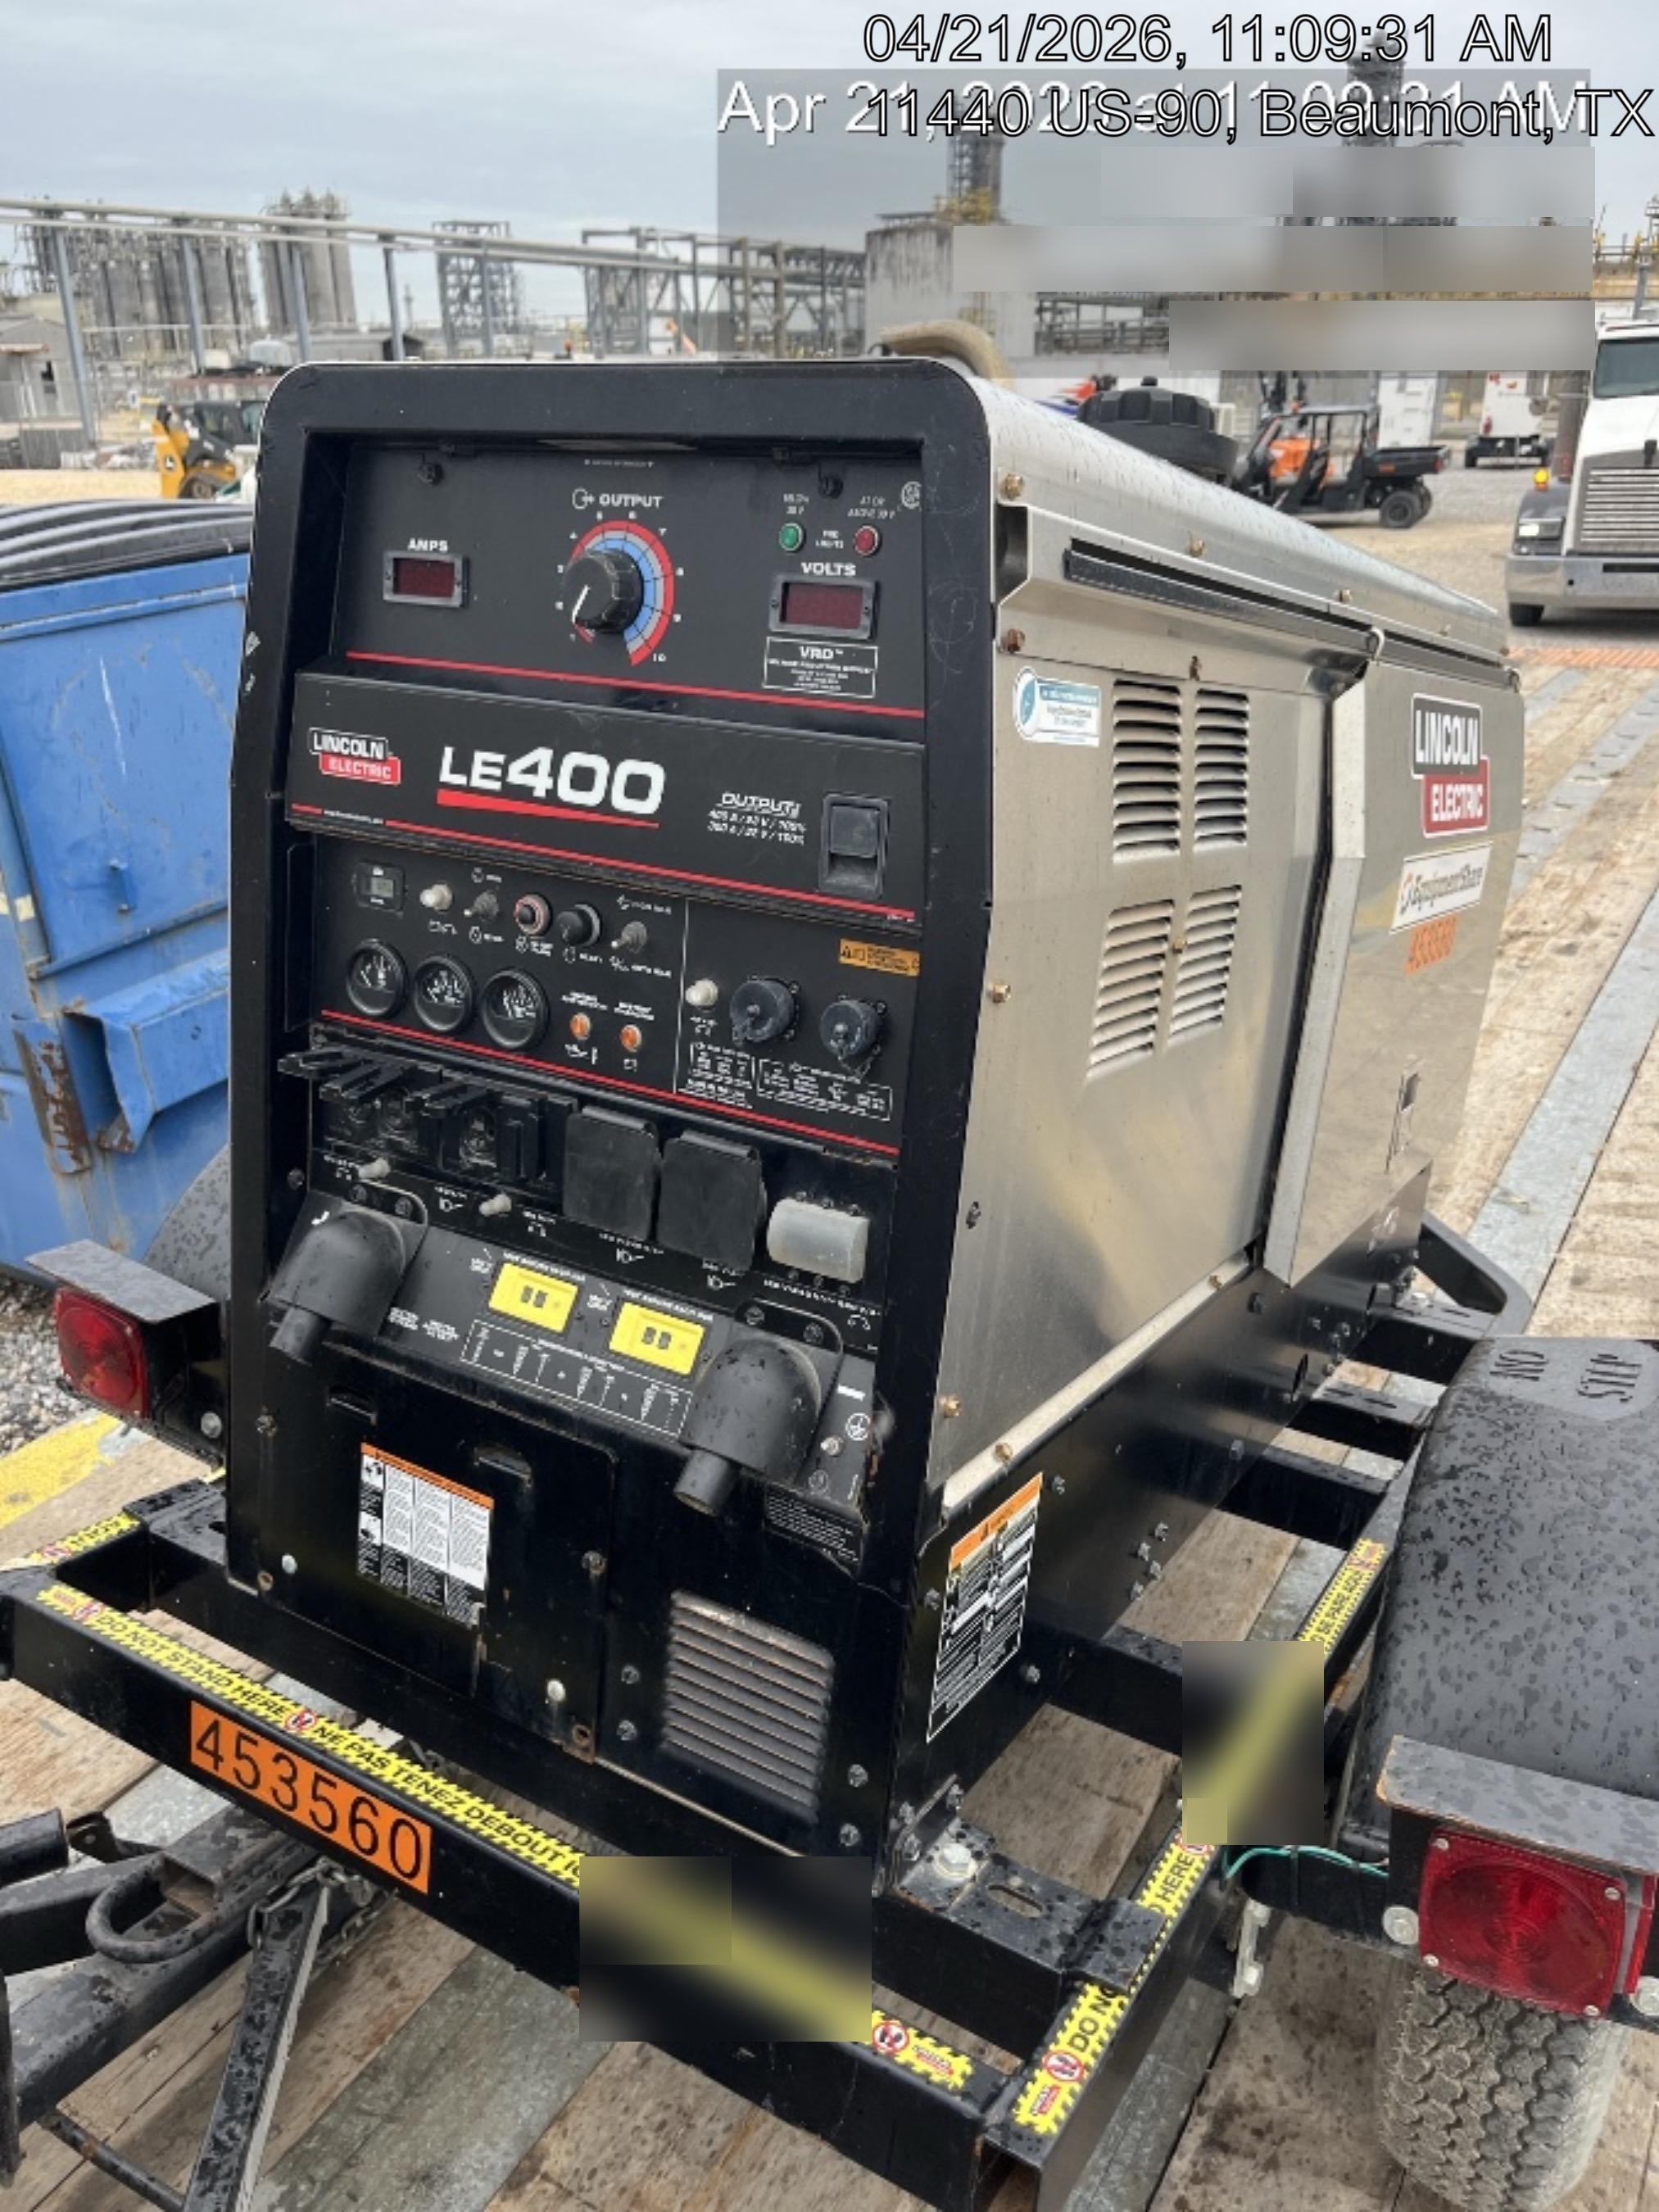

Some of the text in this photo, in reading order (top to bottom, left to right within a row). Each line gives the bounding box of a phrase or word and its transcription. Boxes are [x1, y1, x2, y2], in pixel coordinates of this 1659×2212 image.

[598, 493, 664, 508] OUTPUT
[408, 537, 448, 552] AMPS
[801, 562, 856, 577] VOLTS
[313, 732, 384, 759] LINCOLN
[1415, 709, 1478, 765] LINCOLN
[329, 757, 392, 781] ELECTRIC
[439, 746, 666, 814] LE400
[1432, 783, 1484, 822] ELECTRIC
[97, 1615, 286, 1717] DO NOT STAND HERE
[196, 1720, 422, 1879] 453560
[314, 1725, 565, 1861] NE PAS TENEZ DEBOUT
[1157, 1852, 1194, 1902] HERE
[1067, 2017, 1099, 2051] DO
